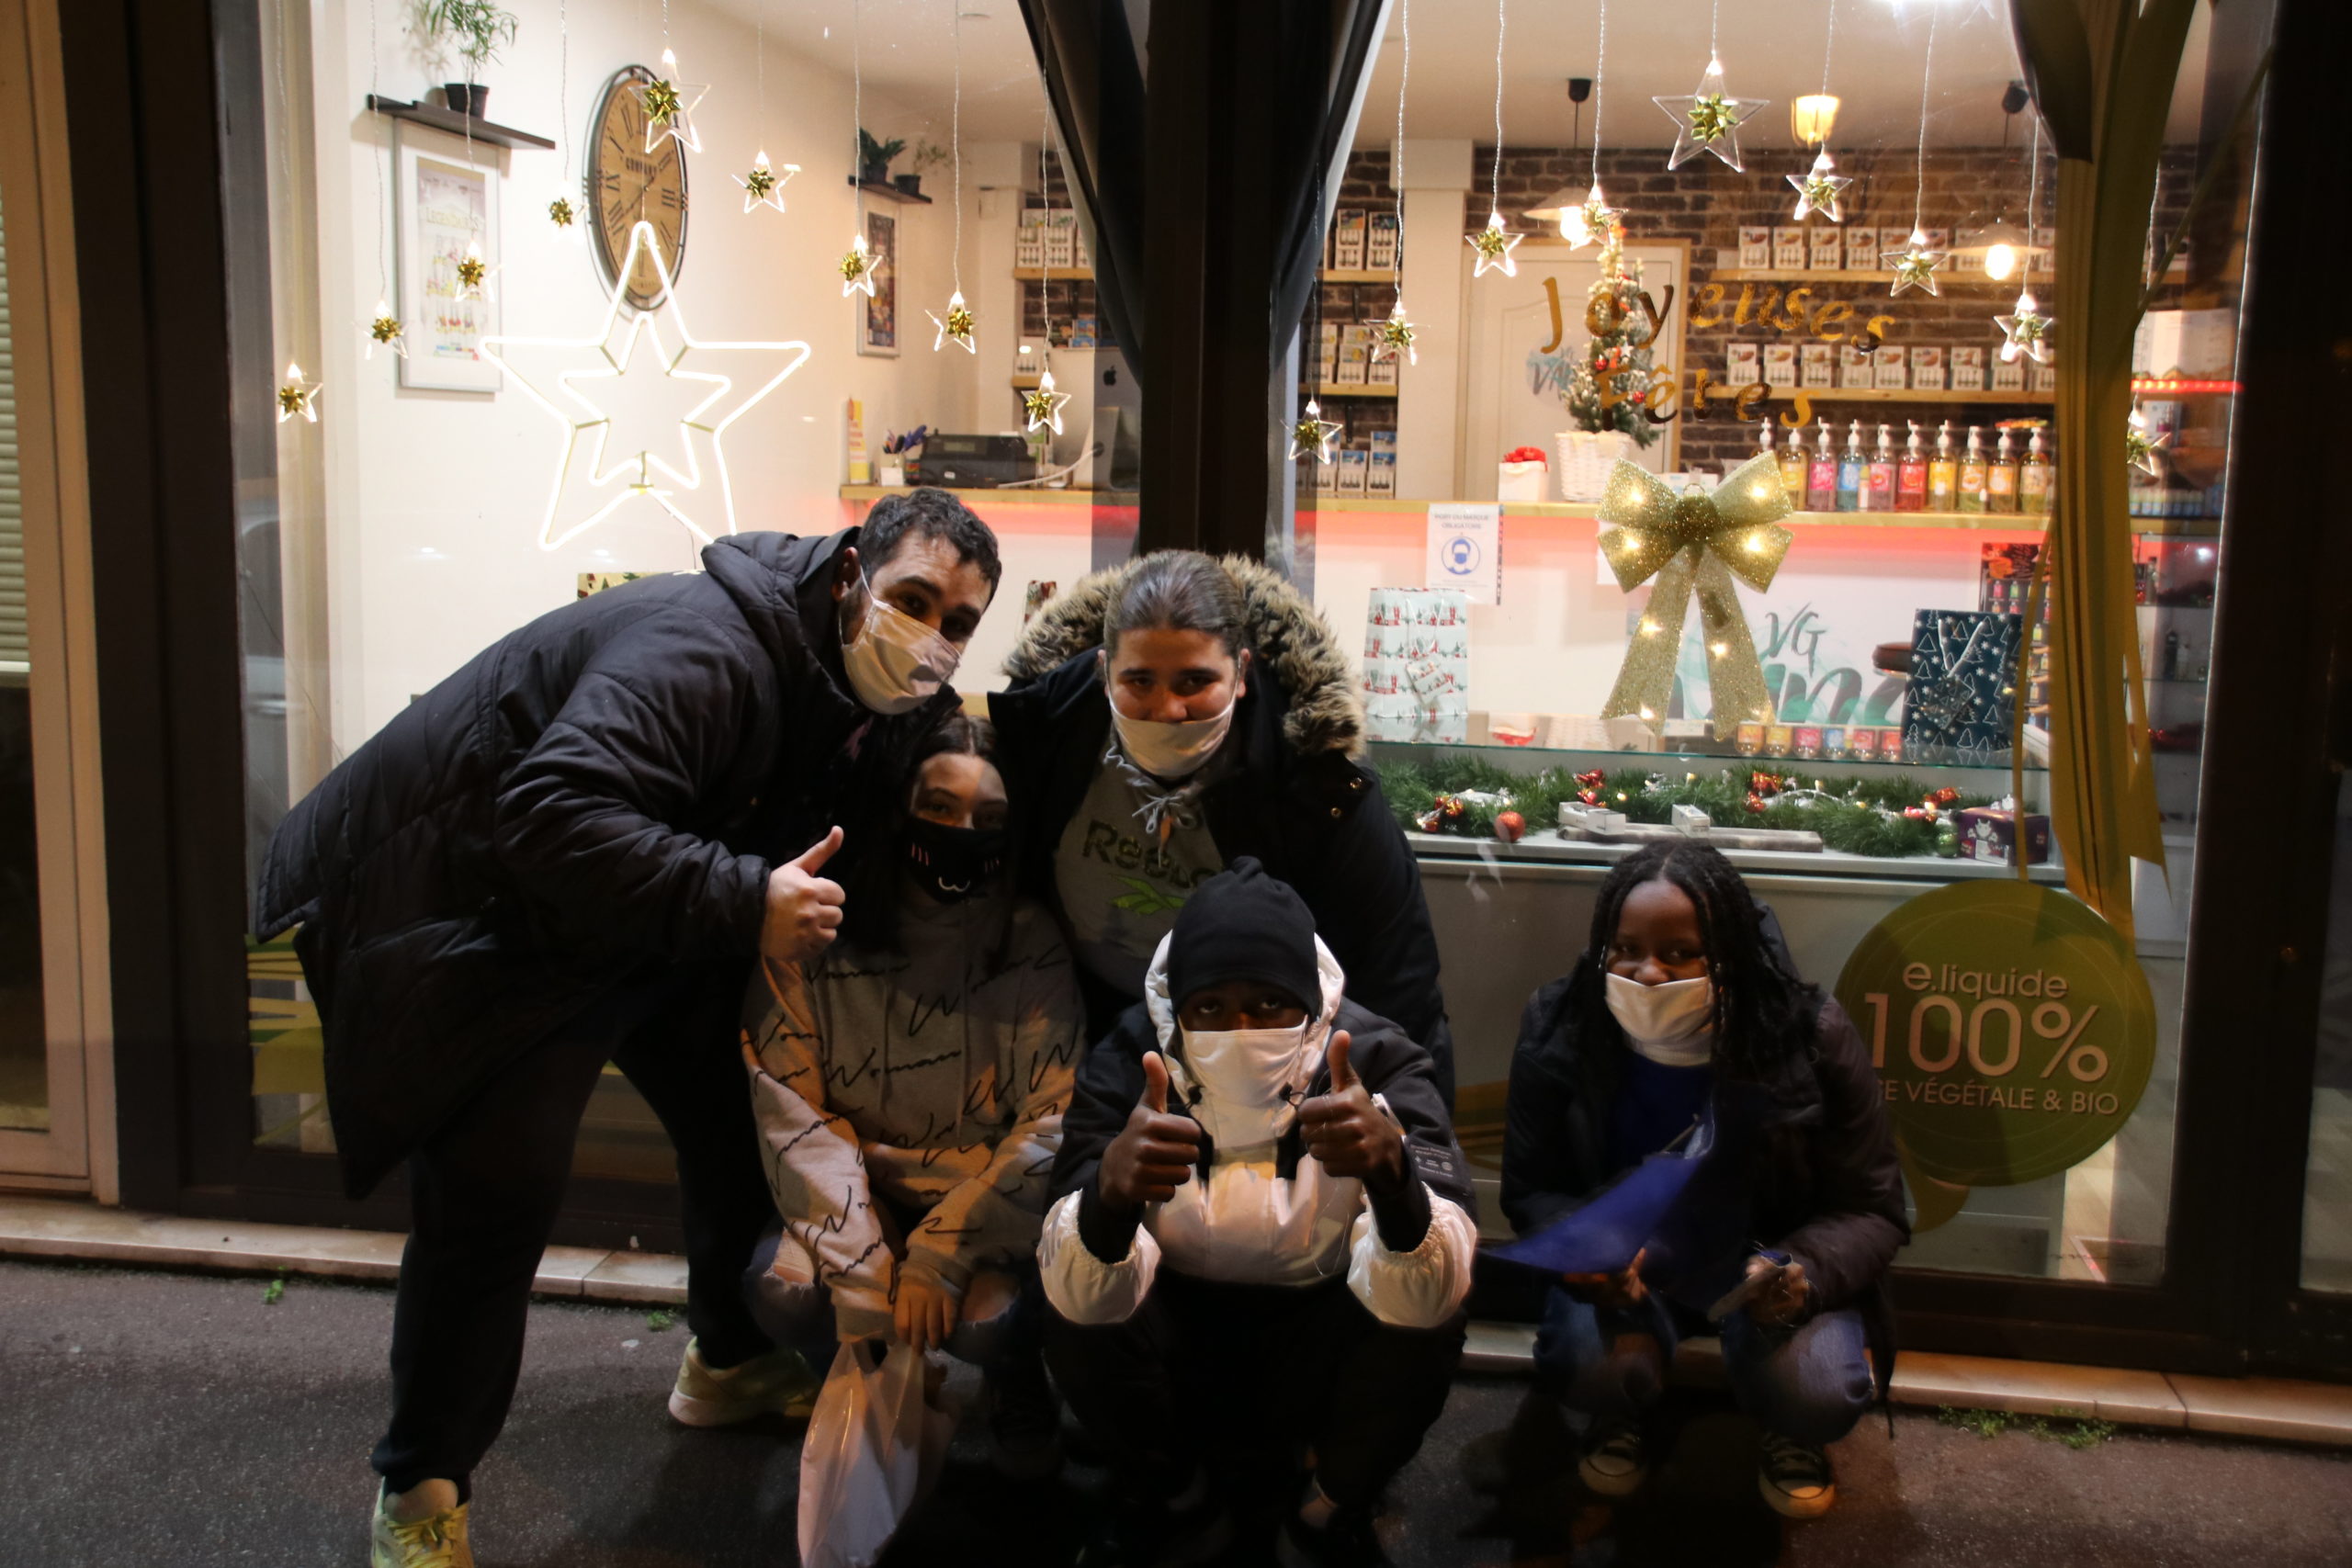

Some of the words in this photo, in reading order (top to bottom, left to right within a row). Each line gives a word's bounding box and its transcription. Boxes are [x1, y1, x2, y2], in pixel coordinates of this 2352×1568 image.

[1540, 276, 1895, 354] Joyeuses
[1593, 364, 1821, 431] Fêtes
[1903, 962, 2068, 999] e.liquide
[1864, 992, 2109, 1083] 100%
[1905, 1077, 2035, 1111] VÉGÉTALE
[2042, 1089, 2063, 1111] &
[2070, 1090, 2119, 1115] BIO
